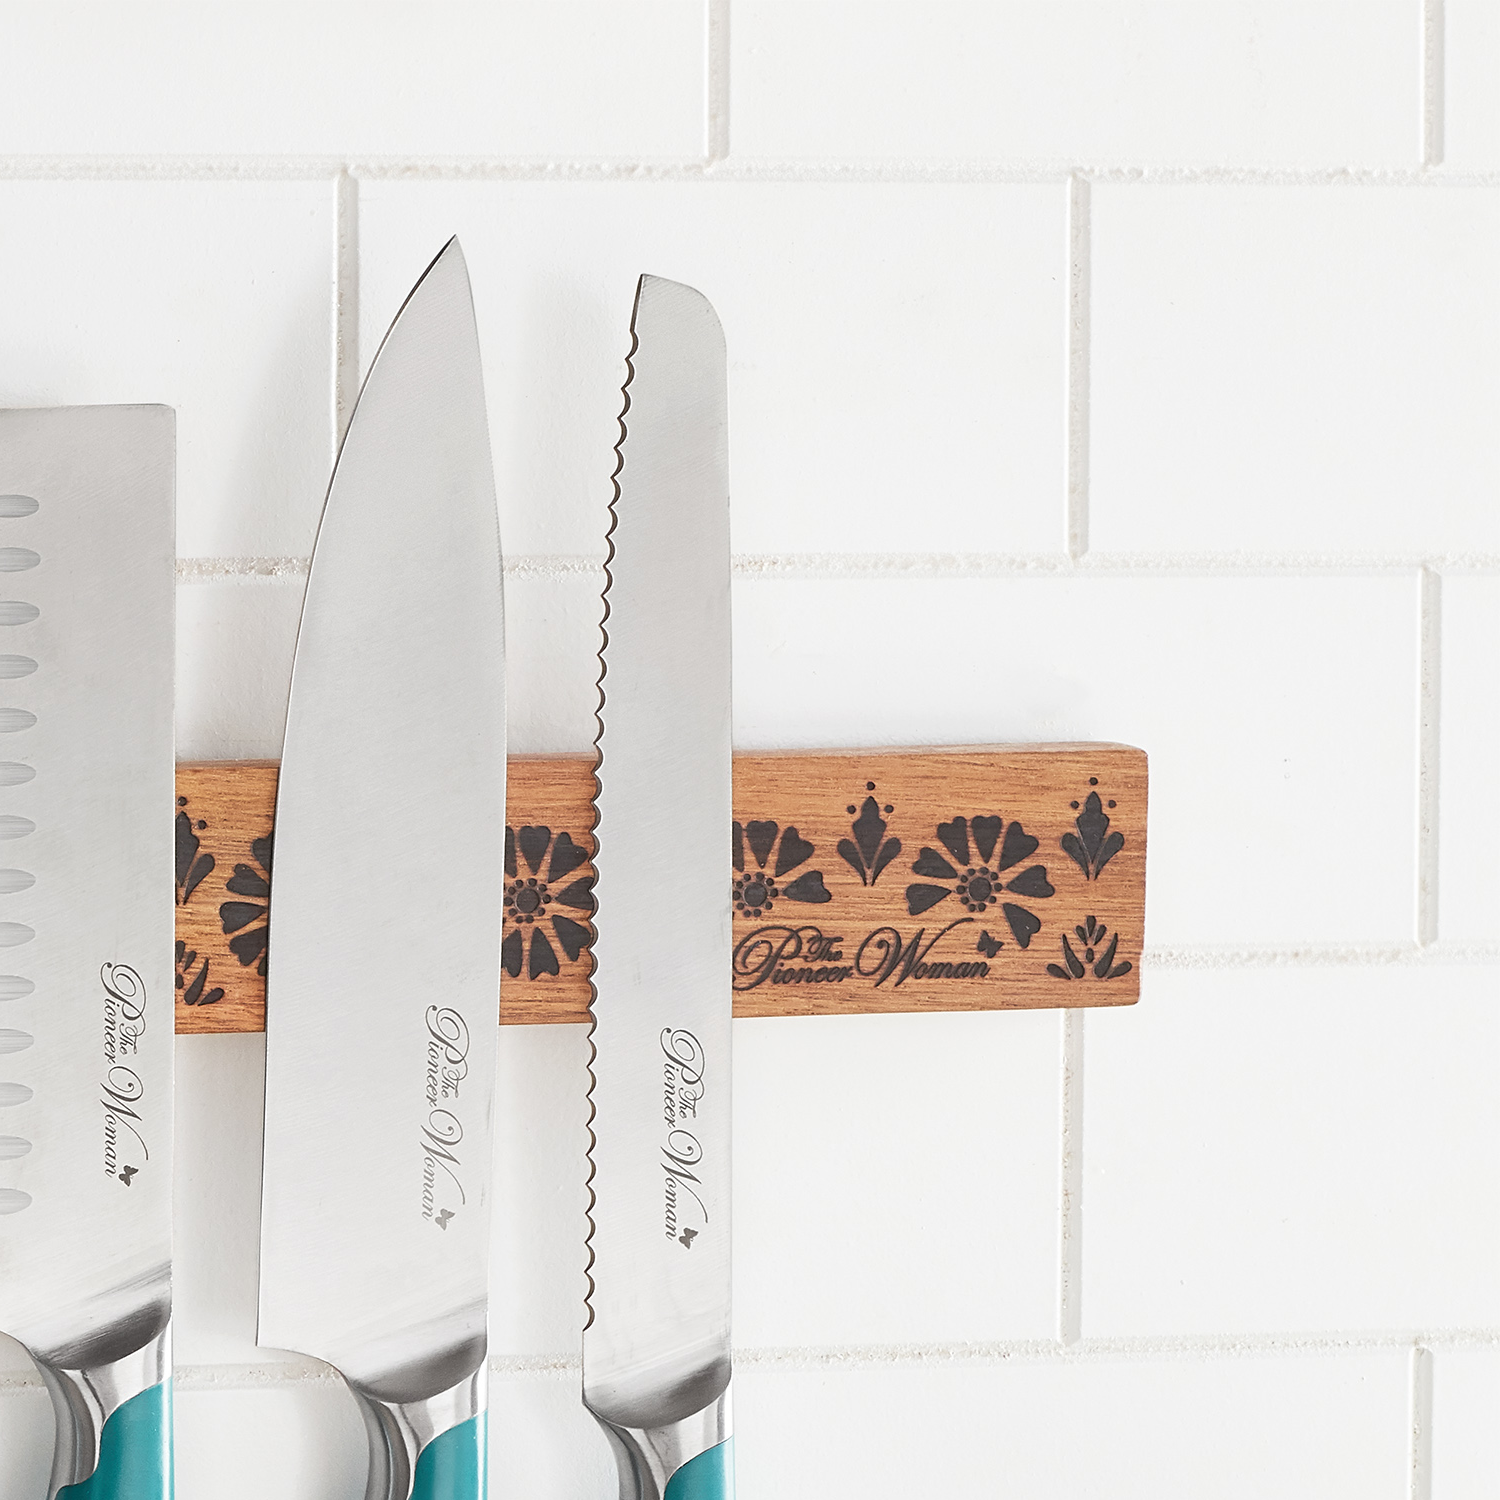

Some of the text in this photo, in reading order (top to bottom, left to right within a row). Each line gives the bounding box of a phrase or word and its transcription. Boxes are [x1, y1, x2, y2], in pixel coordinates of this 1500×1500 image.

[732, 917, 991, 991] The Pioneer Woman
[99, 961, 149, 1178] The Pioneer Woman
[419, 1004, 470, 1221] The Pioneer Woman
[659, 1027, 709, 1241] The Pioneer Woman
